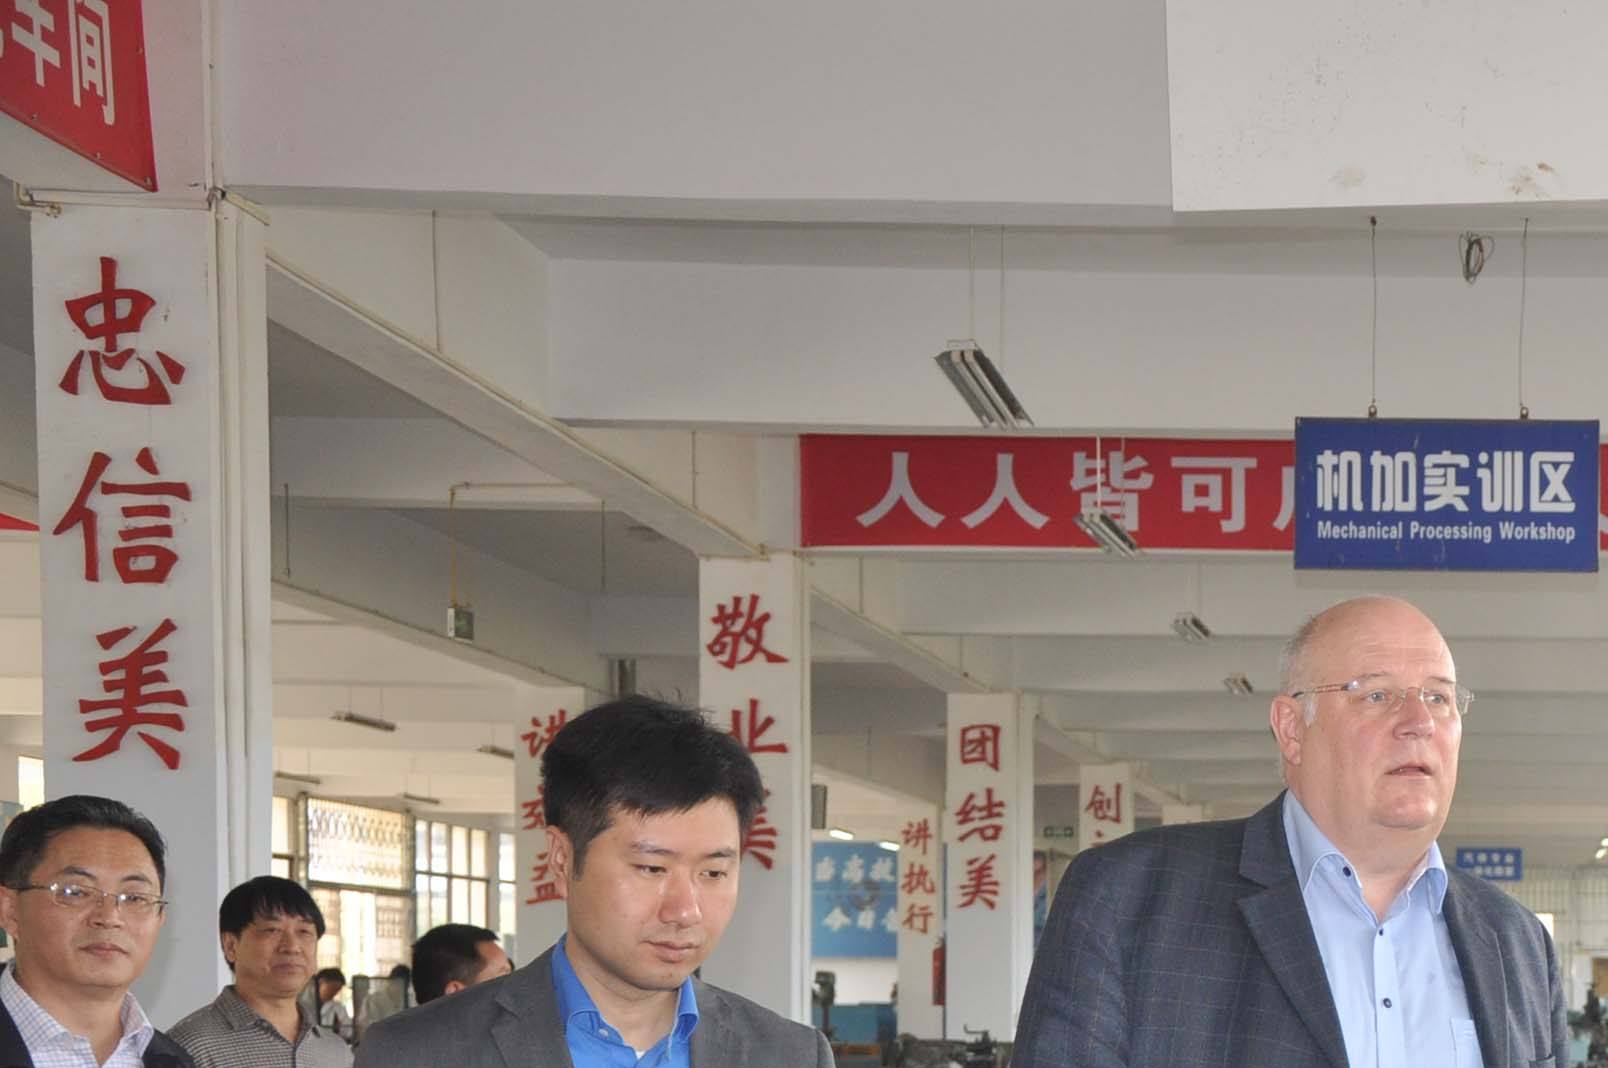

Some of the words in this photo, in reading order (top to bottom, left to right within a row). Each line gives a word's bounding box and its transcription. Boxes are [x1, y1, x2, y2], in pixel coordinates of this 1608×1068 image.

[0, 0, 116, 126] 车间
[53, 256, 191, 770] 忠信美
[856, 450, 1294, 534] 人人皆可
[1316, 449, 1576, 512] 机加实训区
[1317, 520, 1403, 540] Mechanical
[1410, 520, 1492, 544] Processing
[1500, 520, 1576, 544] Workshop
[956, 722, 1006, 911] 团结美
[1085, 782, 1122, 848] 创
[901, 818, 936, 934] 讲执行
